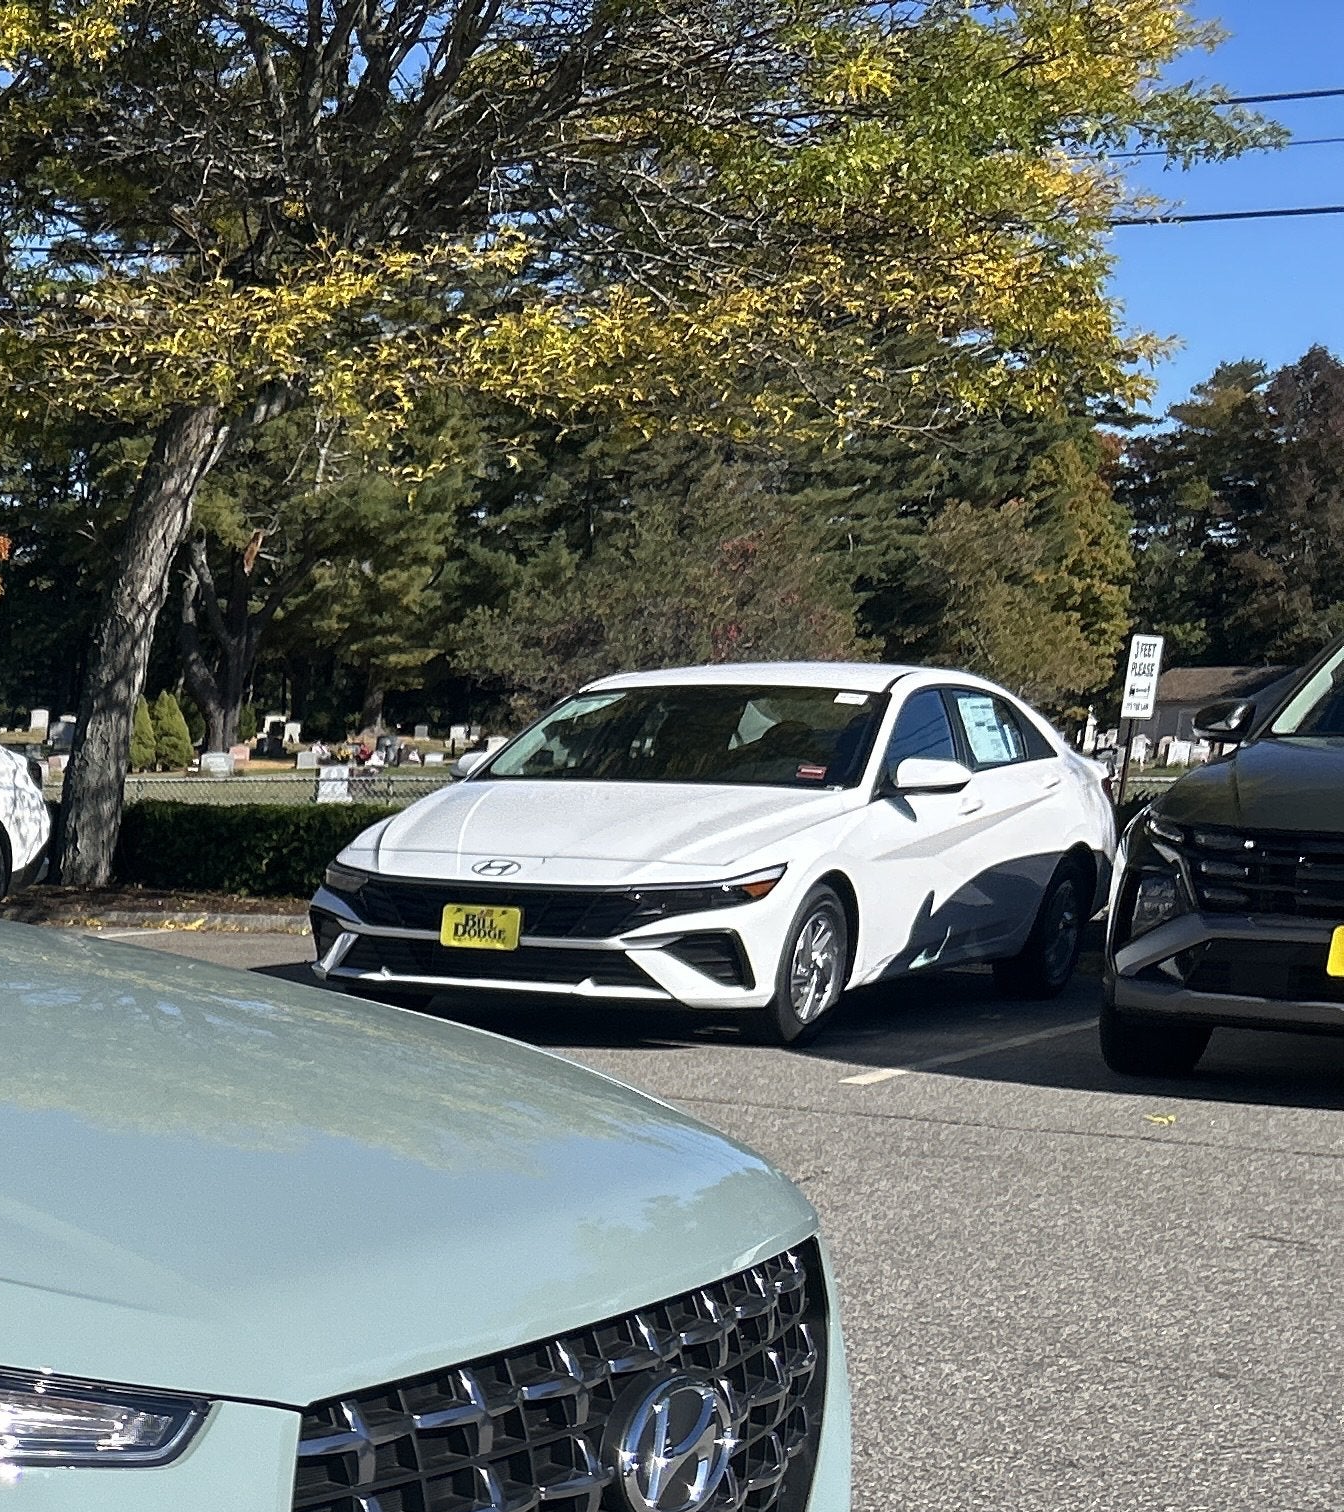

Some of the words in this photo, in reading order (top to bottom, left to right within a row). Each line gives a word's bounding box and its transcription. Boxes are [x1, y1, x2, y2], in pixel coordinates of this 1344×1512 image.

[1140, 643, 1157, 658] FEET
[1131, 662, 1155, 677] PLEASE
[465, 914, 497, 930] BILL
[454, 923, 506, 939] DODGE
